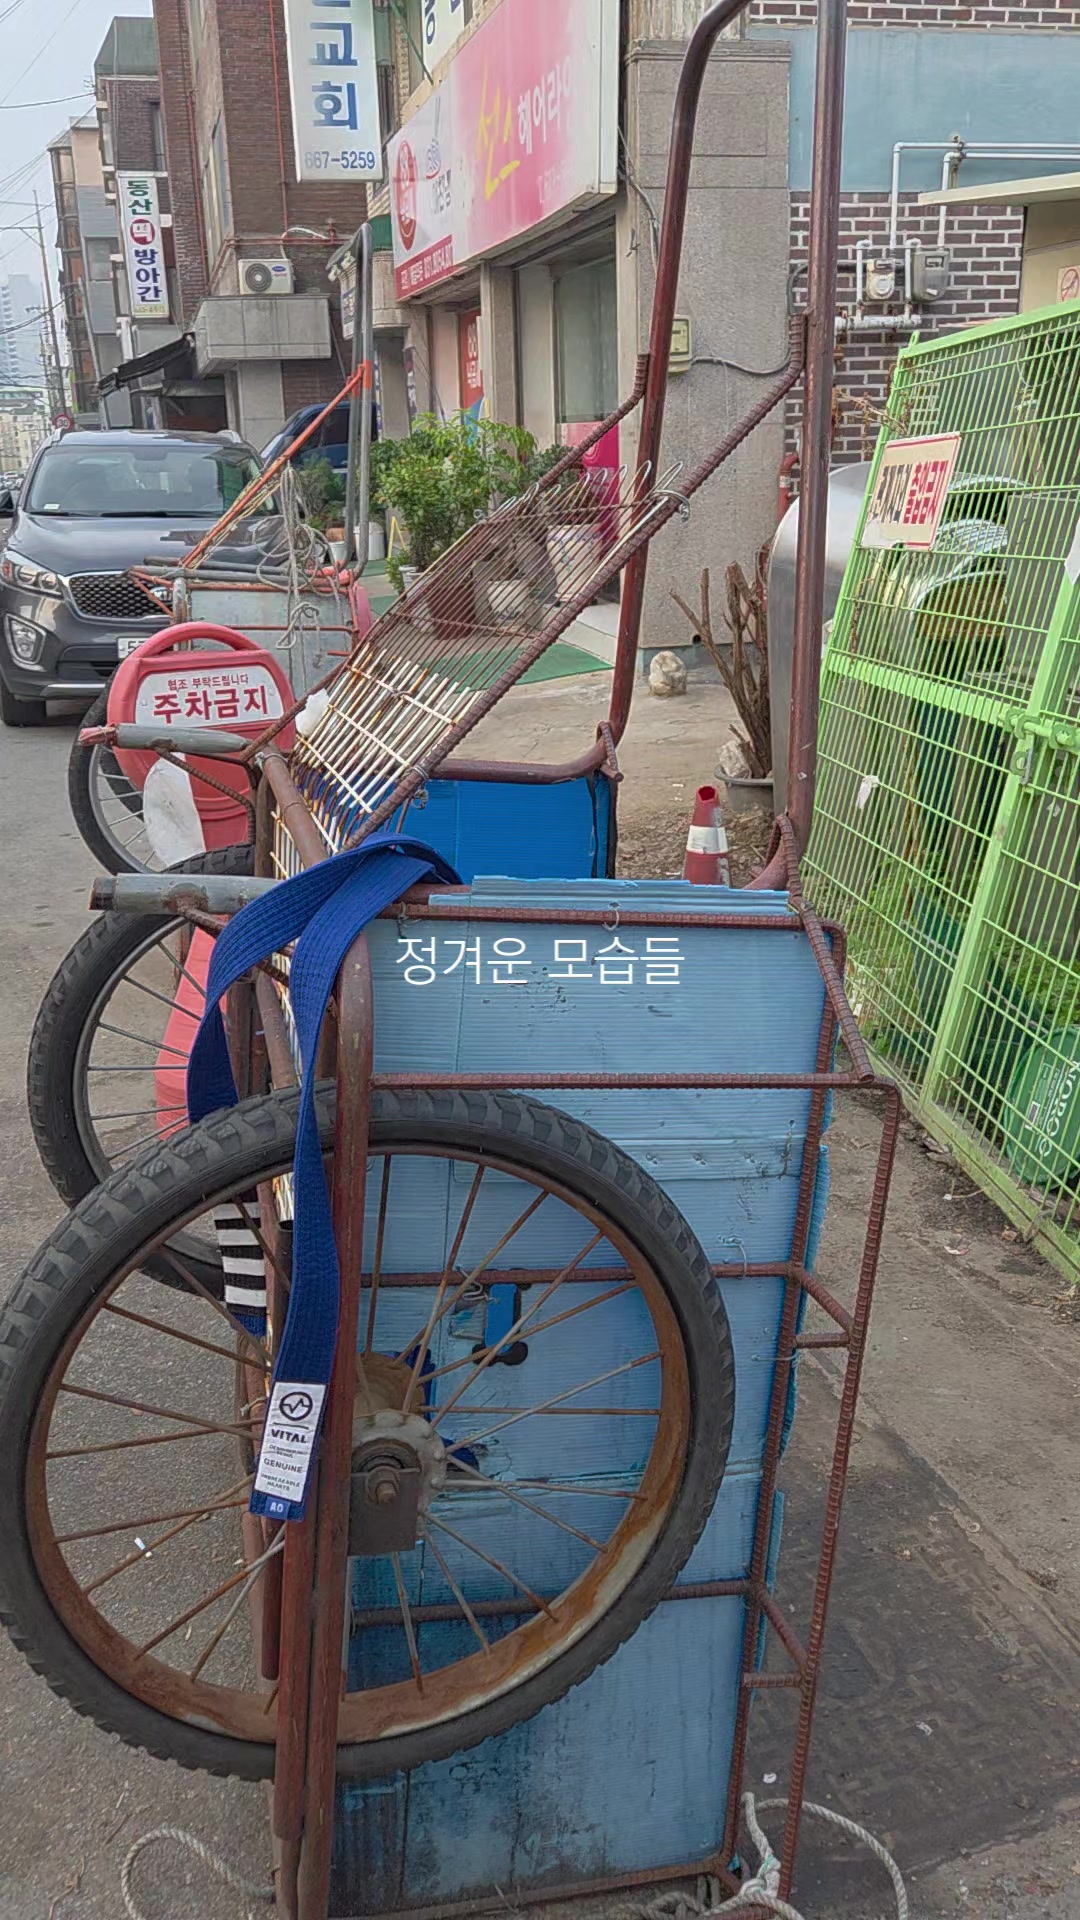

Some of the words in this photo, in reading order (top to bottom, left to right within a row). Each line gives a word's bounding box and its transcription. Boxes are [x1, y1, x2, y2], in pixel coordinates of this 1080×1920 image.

[310, 0, 358, 130] 교회
[304, 151, 376, 169] 667-5259
[167, 678, 189, 692] 협조
[192, 673, 249, 688] 부탁드립니다
[153, 684, 269, 724] 주차금지
[271, 1428, 307, 1444] VITAL
[263, 1457, 303, 1473] GENUINE
